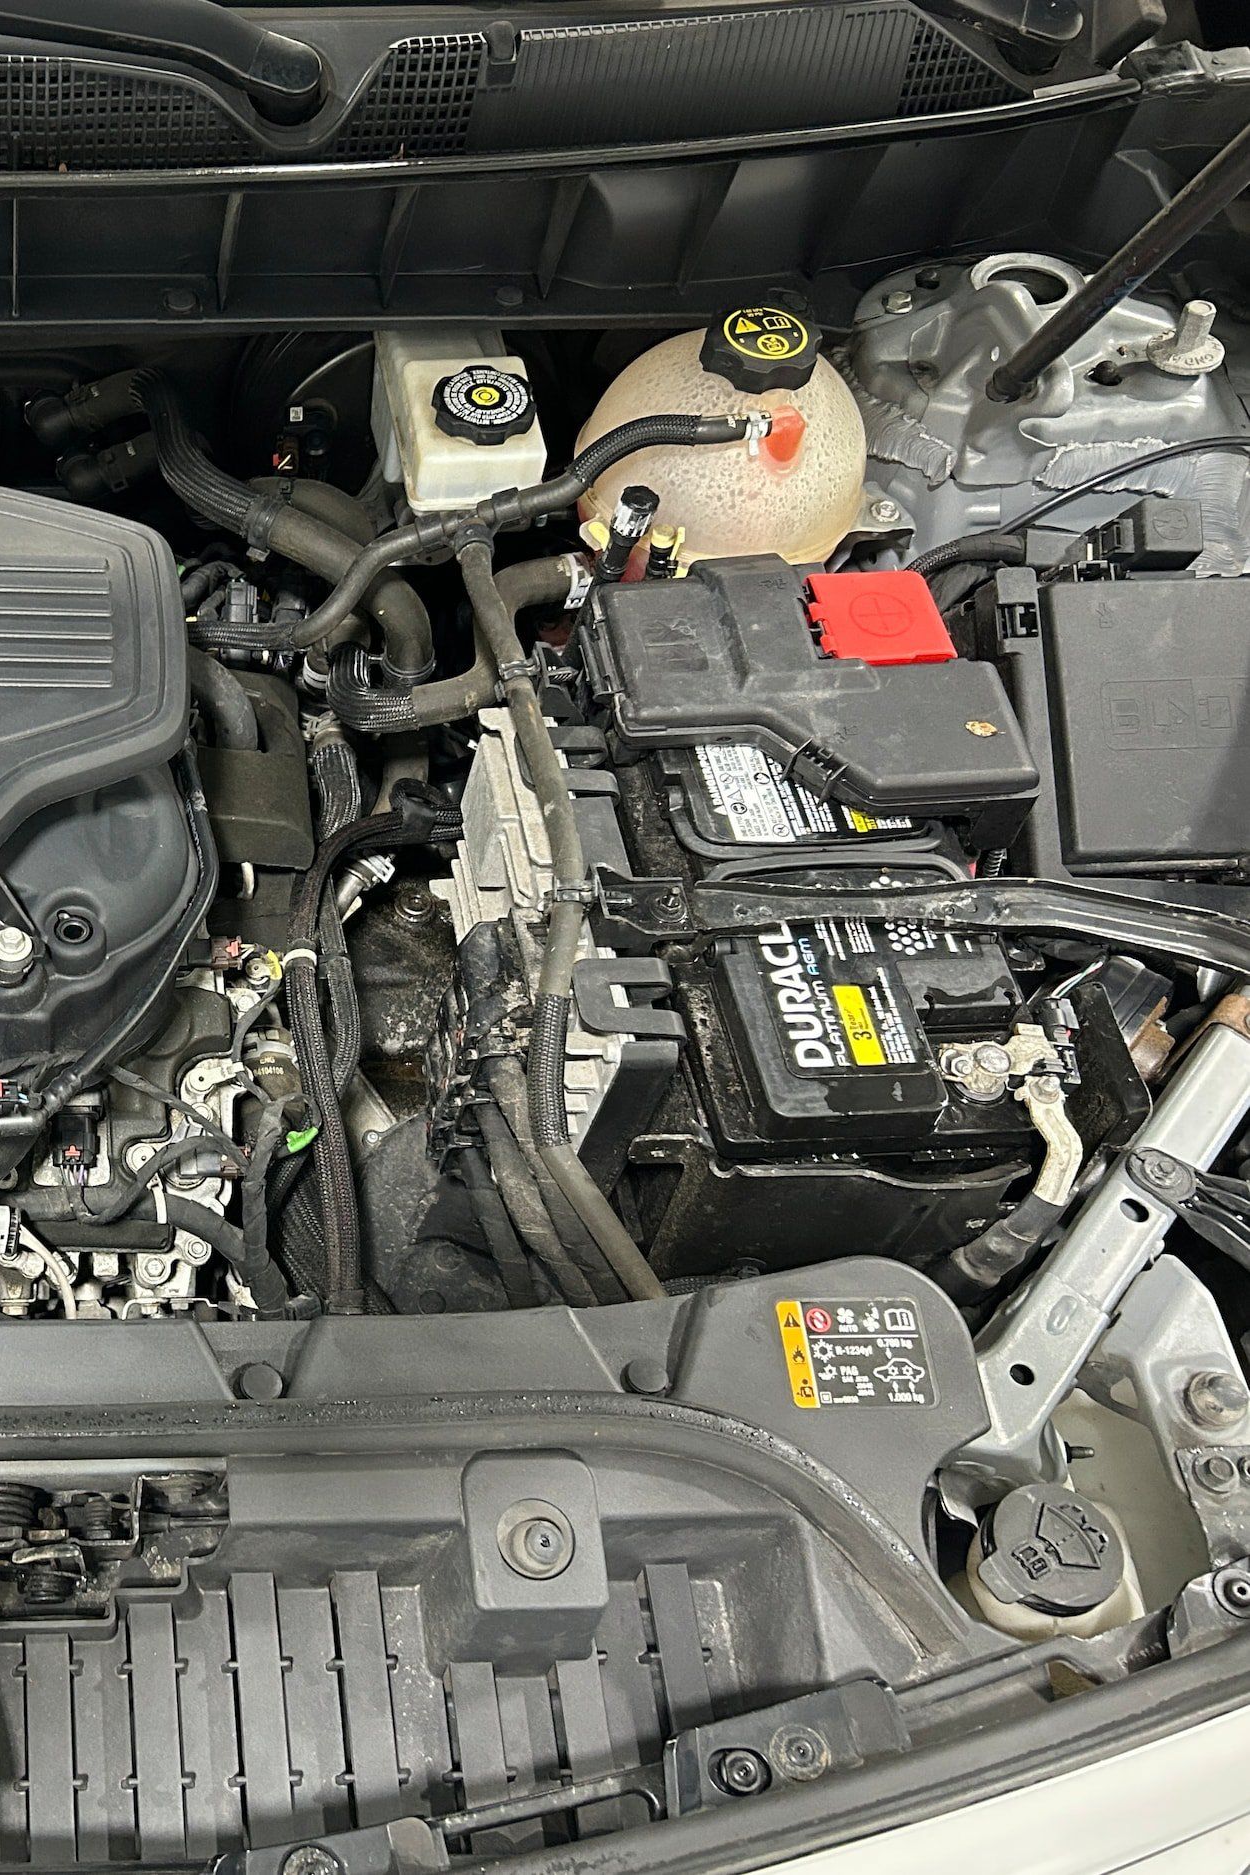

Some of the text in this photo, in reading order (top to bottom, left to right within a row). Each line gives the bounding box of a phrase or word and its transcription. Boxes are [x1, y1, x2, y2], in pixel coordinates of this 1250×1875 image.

[797, 937, 820, 975] AGM
[811, 980, 851, 1067] PLATINUM
[852, 1031, 873, 1041] 3
[900, 1338, 913, 1349] kg
[839, 1365, 859, 1376] PAG
[887, 1392, 925, 1404] 1.000 kg
